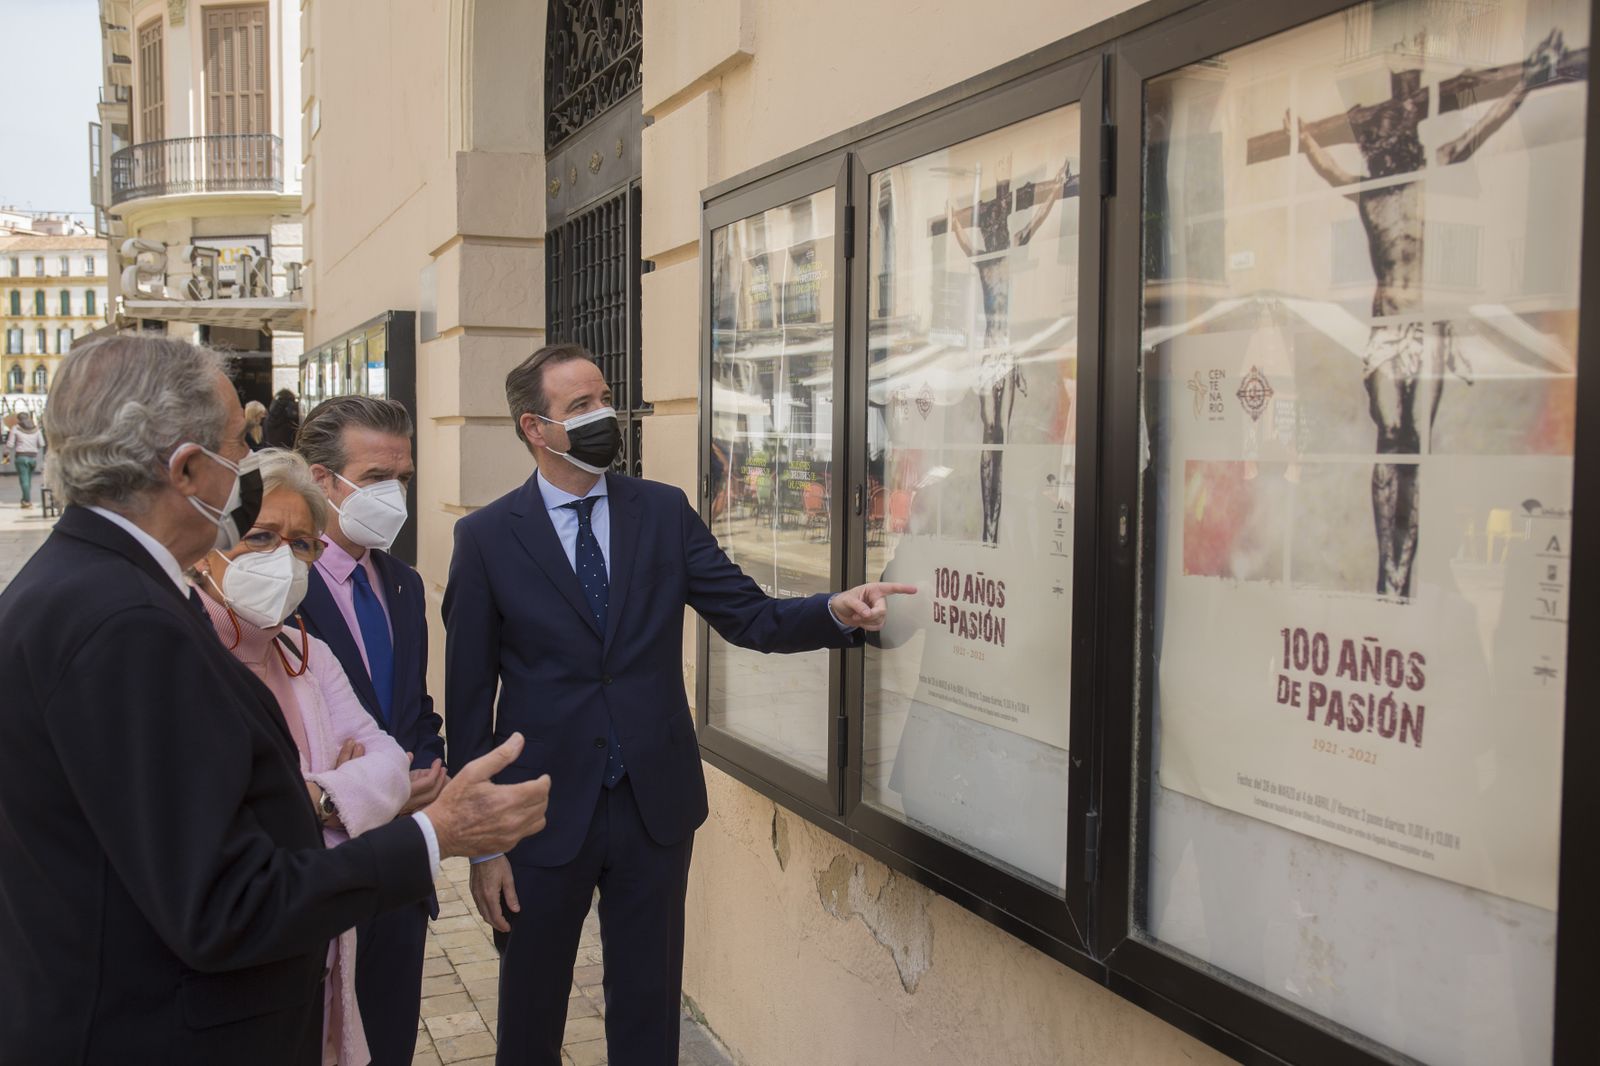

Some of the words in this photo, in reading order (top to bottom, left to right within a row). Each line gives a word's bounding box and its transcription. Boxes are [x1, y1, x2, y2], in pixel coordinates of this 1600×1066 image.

[1209, 369, 1226, 380] CEN
[1209, 380, 1219, 391] TE
[1209, 391, 1223, 402] NA
[1209, 402, 1224, 413] RIO
[934, 567, 960, 602] 100
[962, 571, 1006, 609] AÑOS
[933, 601, 947, 625] DE
[949, 605, 1006, 648] PASIÓN
[1280, 627, 1330, 677] 100
[1336, 636, 1427, 692] AÑOS
[1276, 674, 1302, 709] DE
[1307, 680, 1426, 749] PASIÓN
[1312, 738, 1338, 755] 1921
[1348, 746, 1378, 766] 2021
